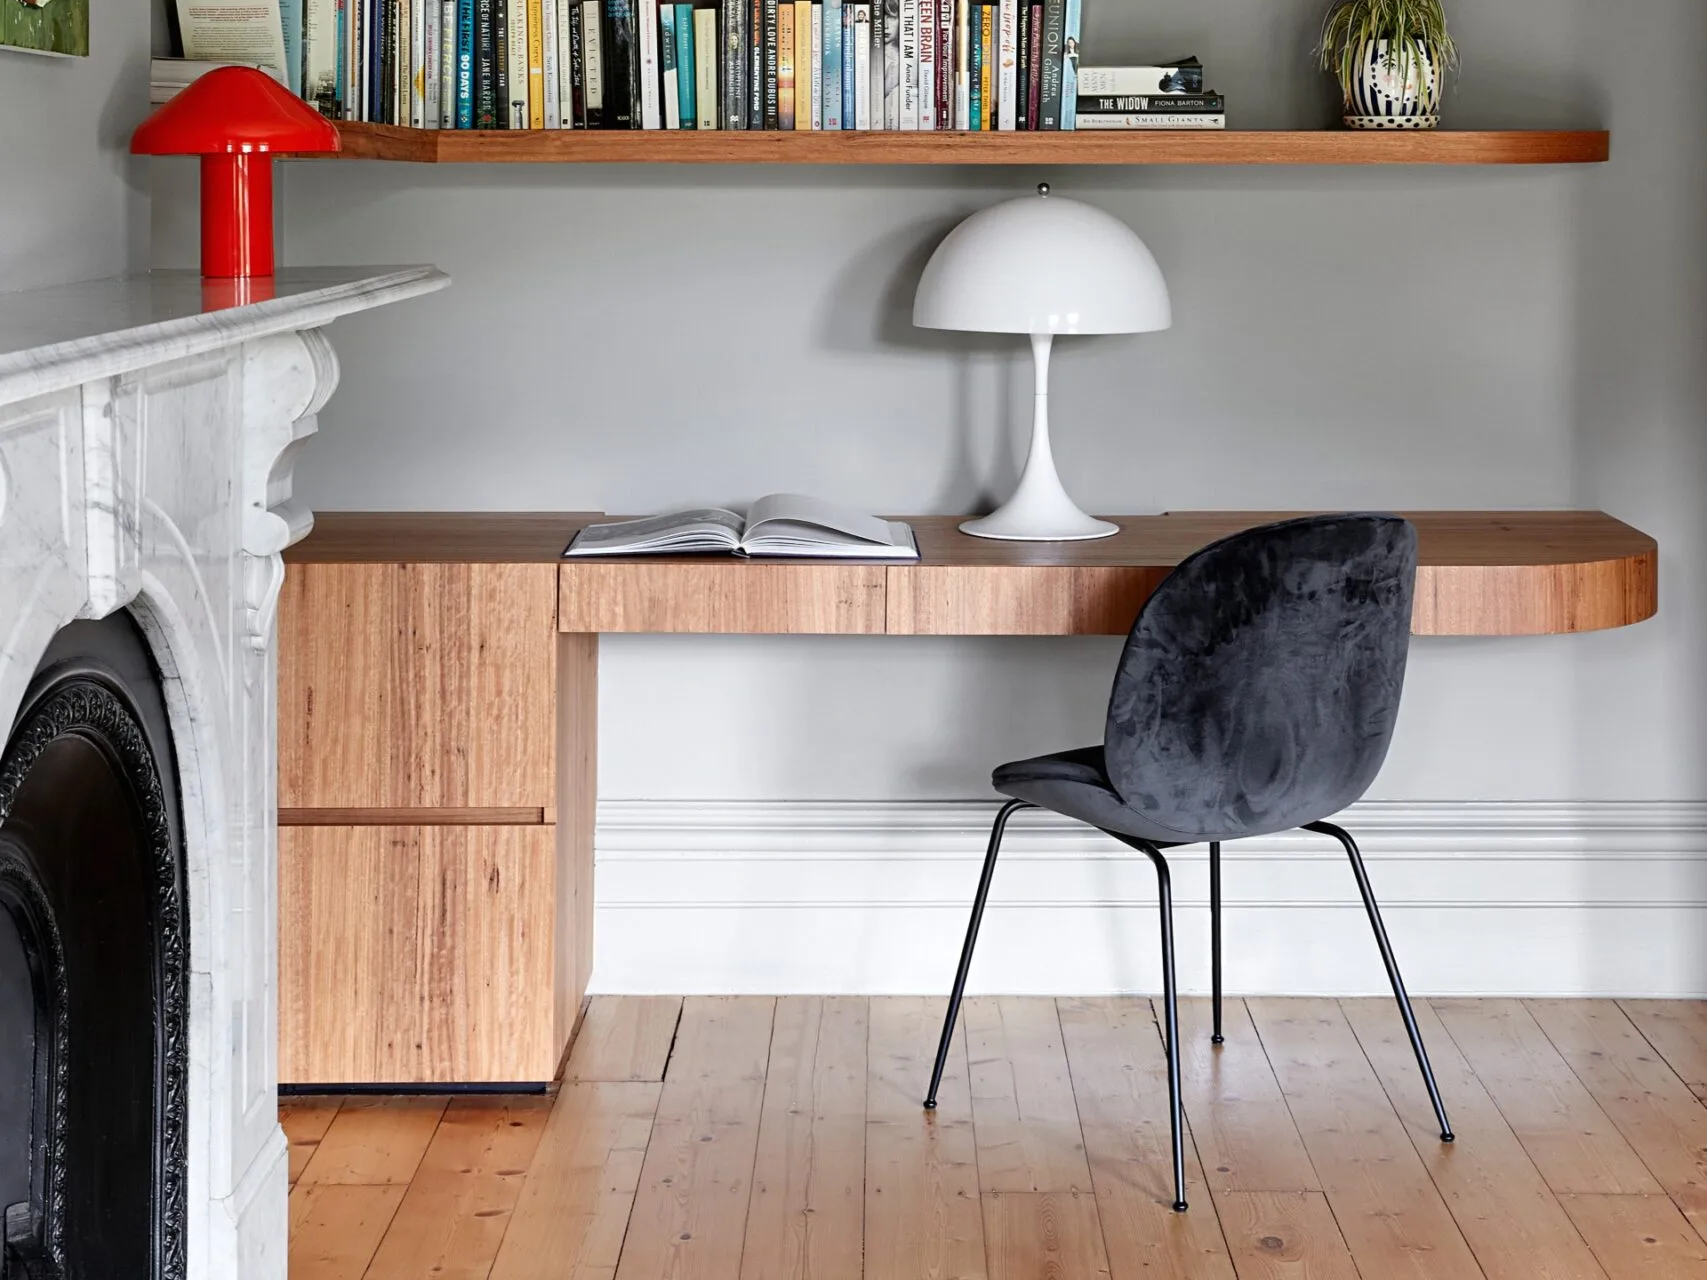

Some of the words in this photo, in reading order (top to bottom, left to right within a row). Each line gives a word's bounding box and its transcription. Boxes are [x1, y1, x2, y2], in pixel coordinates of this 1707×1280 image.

[444, 5, 452, 23] BE
[767, 0, 776, 24] DIRTY
[462, 24, 470, 51] FIRST
[481, 22, 490, 51] NATURE
[767, 27, 776, 46] LOVE
[874, 19, 882, 49] Miller
[904, 15, 914, 36] THAT
[664, 20, 672, 64] Midwives
[904, 44, 914, 58] AM
[920, 27, 932, 63] BRAIN
[443, 28, 452, 84] FIERCE
[461, 55, 469, 69] 90
[482, 58, 490, 76] JANE
[588, 28, 597, 94] EVICTED
[767, 49, 776, 75] ANDRE
[768, 78, 776, 104] DUBUS
[1042, 58, 1051, 103] Goldsmith
[768, 106, 776, 115] III
[1099, 99, 1114, 110] THE
[1116, 98, 1148, 110] WIDOW
